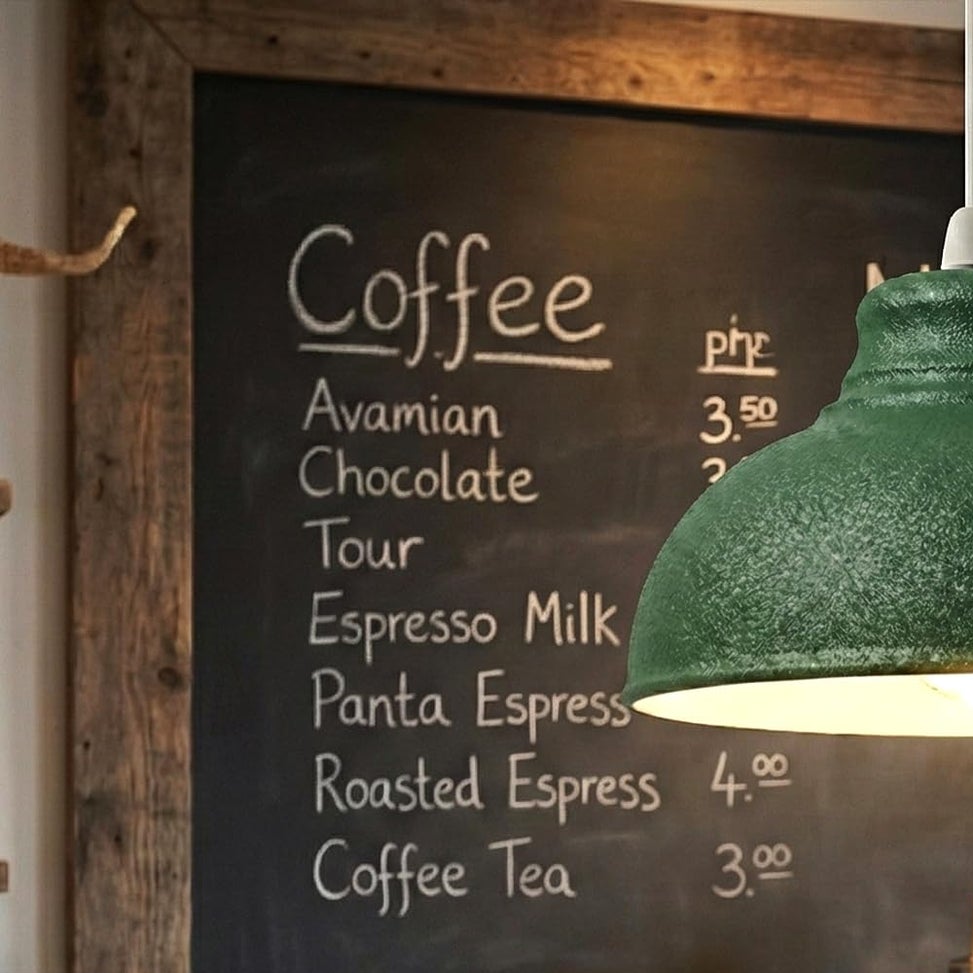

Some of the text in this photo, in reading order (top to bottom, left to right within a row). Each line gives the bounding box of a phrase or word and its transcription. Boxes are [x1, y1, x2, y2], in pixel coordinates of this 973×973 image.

[288, 224, 606, 371] Coffee
[302, 377, 502, 438] Avamian
[700, 396, 778, 444] 3.50
[299, 445, 539, 502] Chocolate
[304, 517, 424, 571] Tour
[308, 590, 620, 665] Espresso Milk
[311, 668, 631, 743] Panta Espress
[315, 752, 661, 825] Roasted Espress
[313, 836, 576, 917] Coffee Tea
